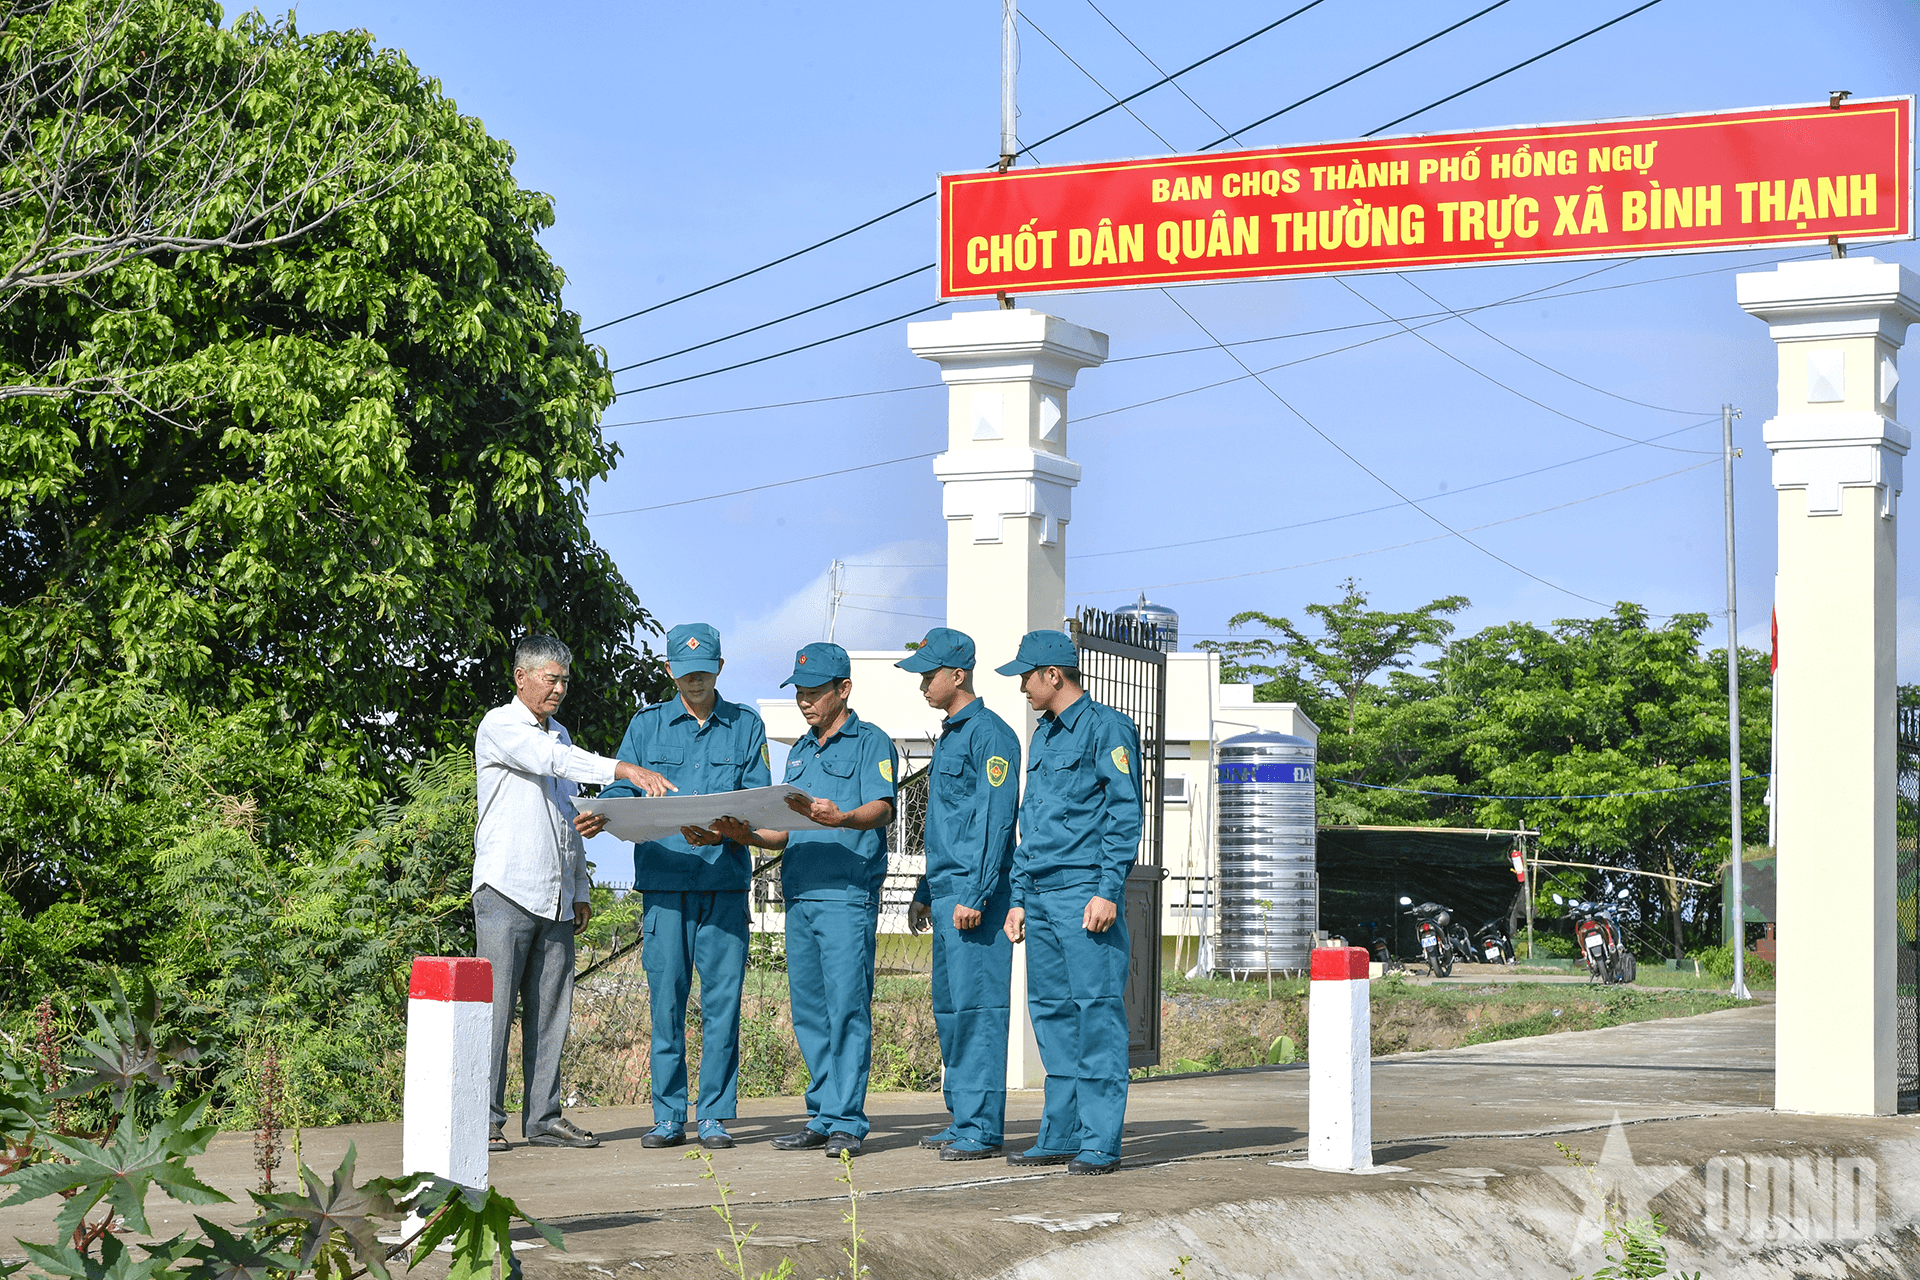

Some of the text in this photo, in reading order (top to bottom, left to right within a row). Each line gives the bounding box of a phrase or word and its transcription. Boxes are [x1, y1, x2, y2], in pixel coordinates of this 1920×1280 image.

[1151, 140, 1658, 204] BAN CHQS THÀNH PHỐ HỒNG NGỰ
[966, 173, 1878, 275] CHỐT DÂN QUÂN THƯỜNG TRỰC XÃ BÌNH THẠNH
